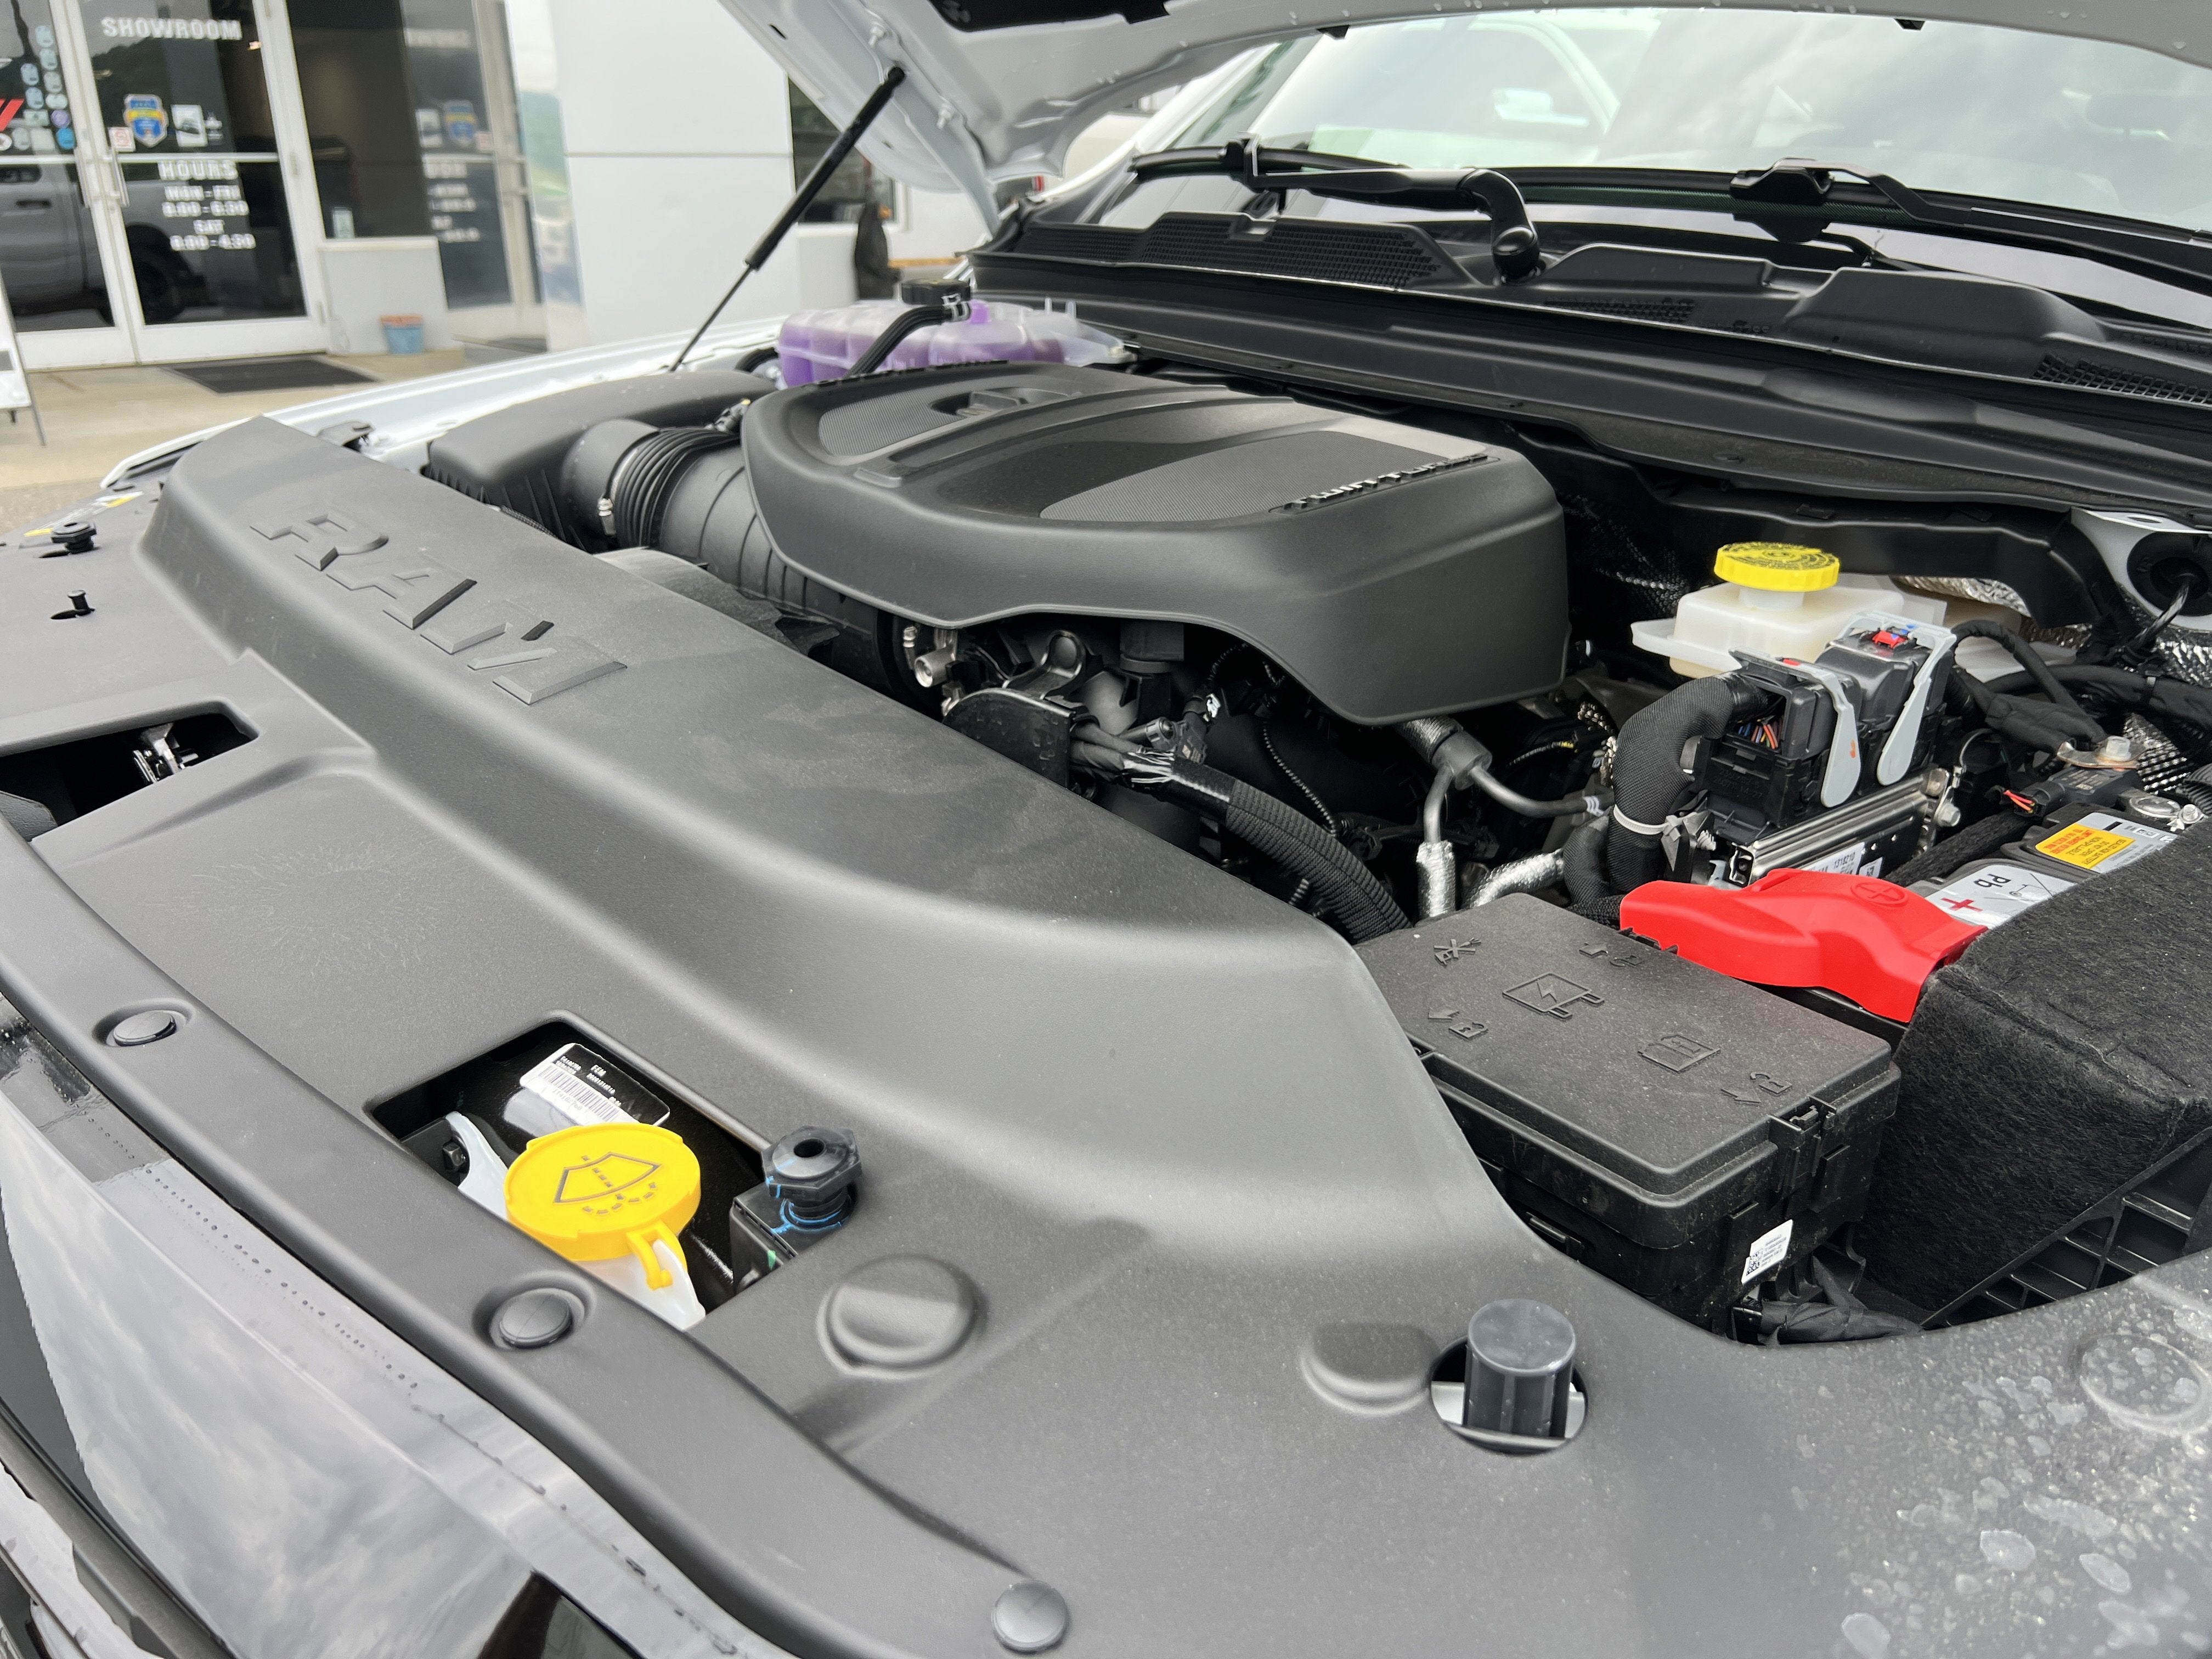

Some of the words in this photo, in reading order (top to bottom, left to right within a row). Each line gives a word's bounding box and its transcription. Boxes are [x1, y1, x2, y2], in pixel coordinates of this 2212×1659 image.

[101, 16, 242, 40] SHOWROOM
[157, 160, 239, 180] HOURS
[1378, 453, 1489, 483] TUR
[250, 506, 628, 706] RAM
[1974, 873, 2012, 888] Pb
[591, 1064, 607, 1076] FEM
